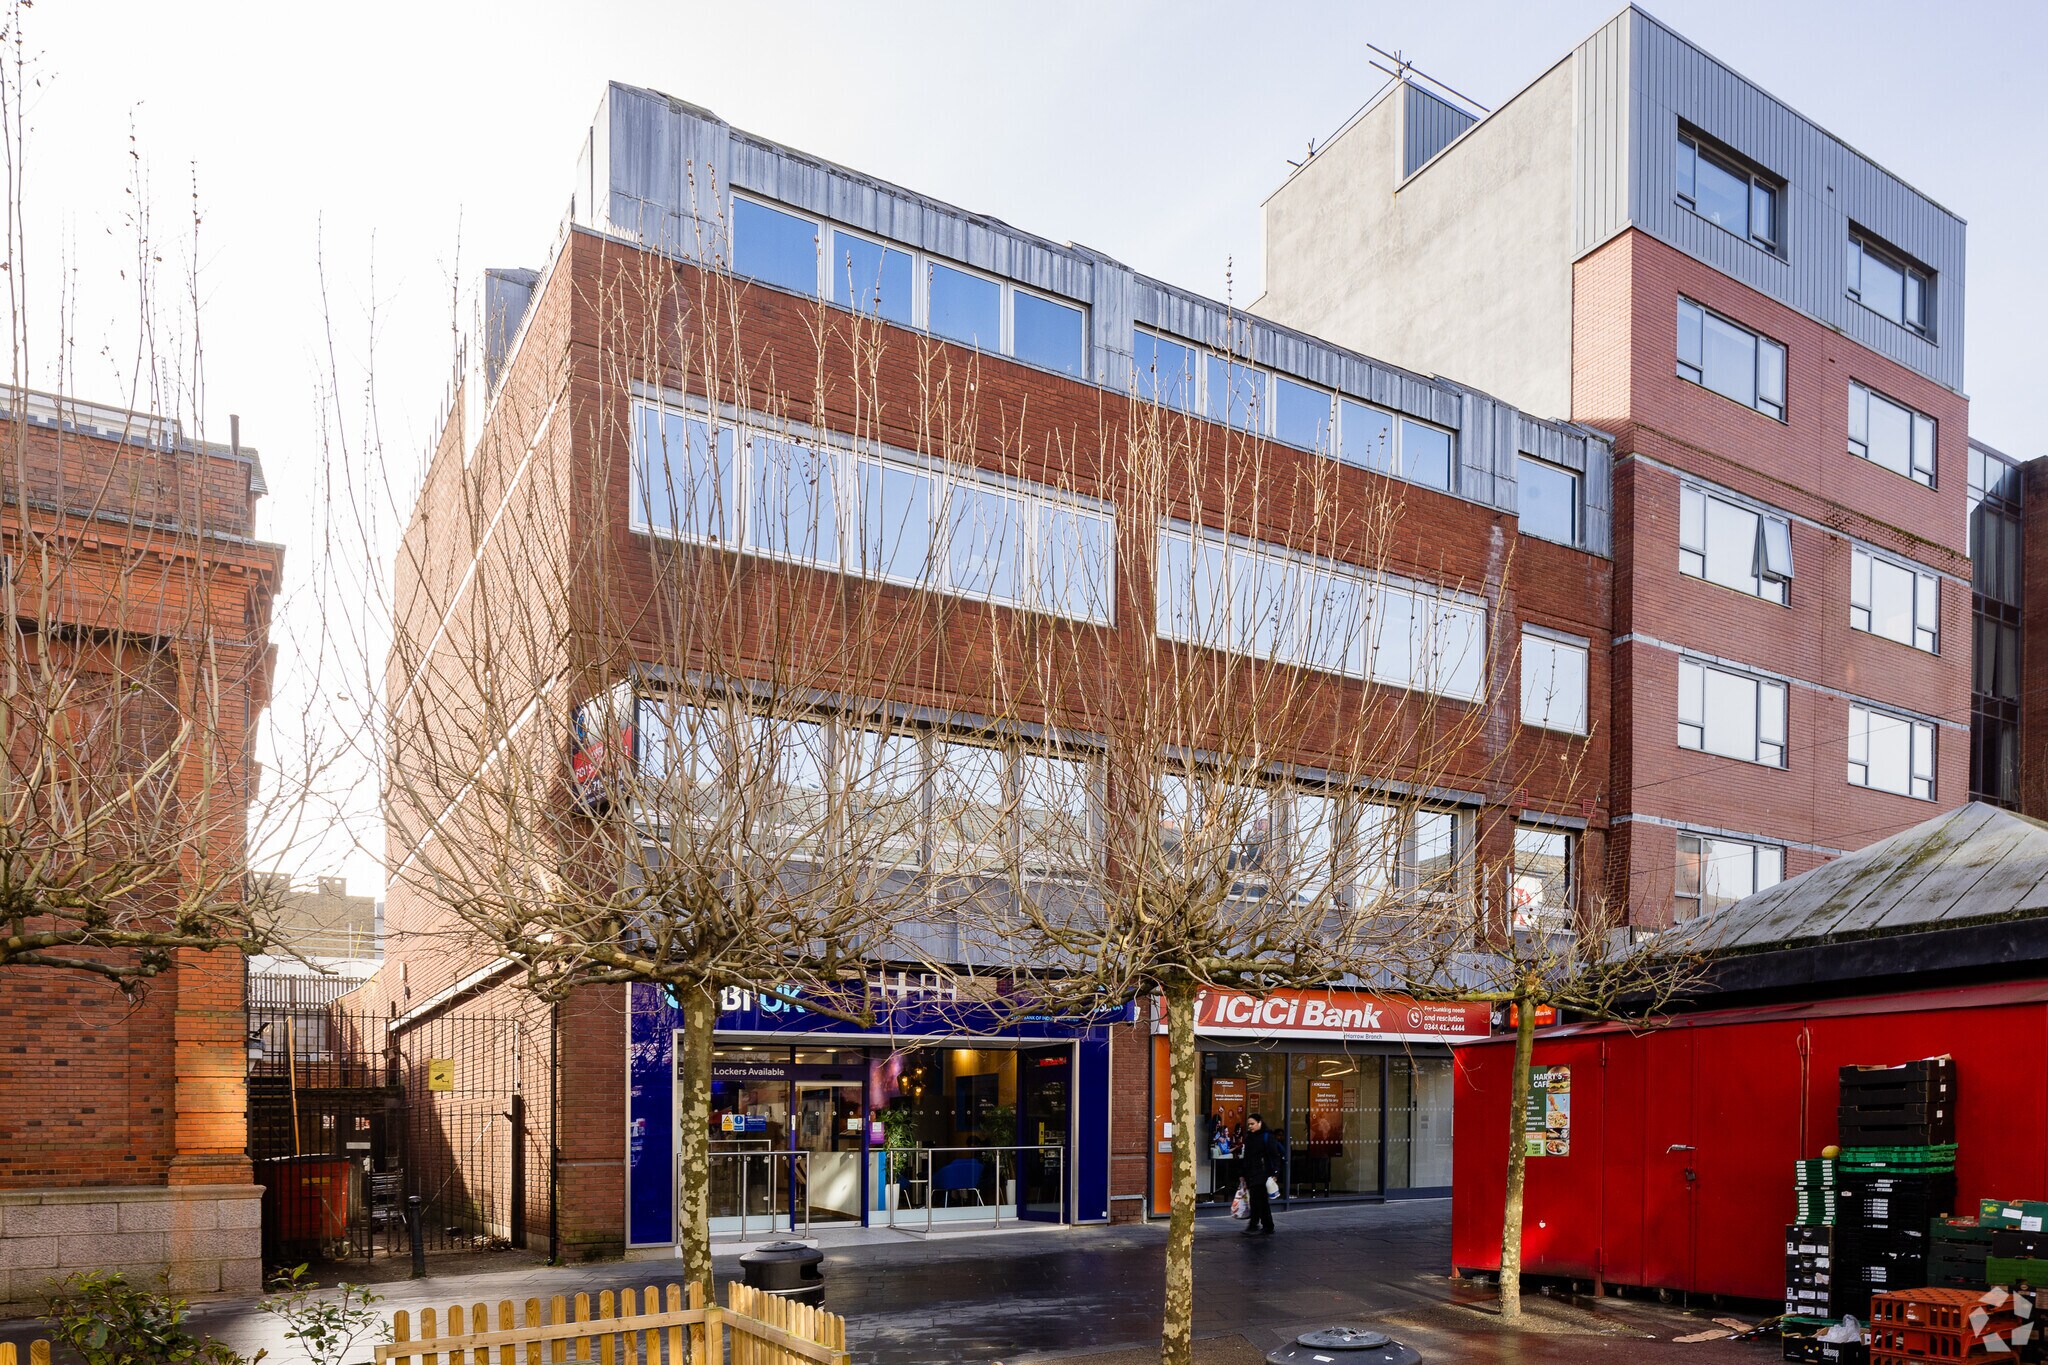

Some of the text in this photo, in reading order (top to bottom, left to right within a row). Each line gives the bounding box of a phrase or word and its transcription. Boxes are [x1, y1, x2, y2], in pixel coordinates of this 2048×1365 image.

[759, 984, 806, 1013] UK
[1215, 995, 1383, 1029] ICICI Bank
[1433, 1006, 1452, 1014] banking
[1534, 1009, 1552, 1017] Bank
[1436, 1014, 1465, 1022] resolution
[714, 1067, 747, 1076] Lockers
[748, 1067, 785, 1076] Available
